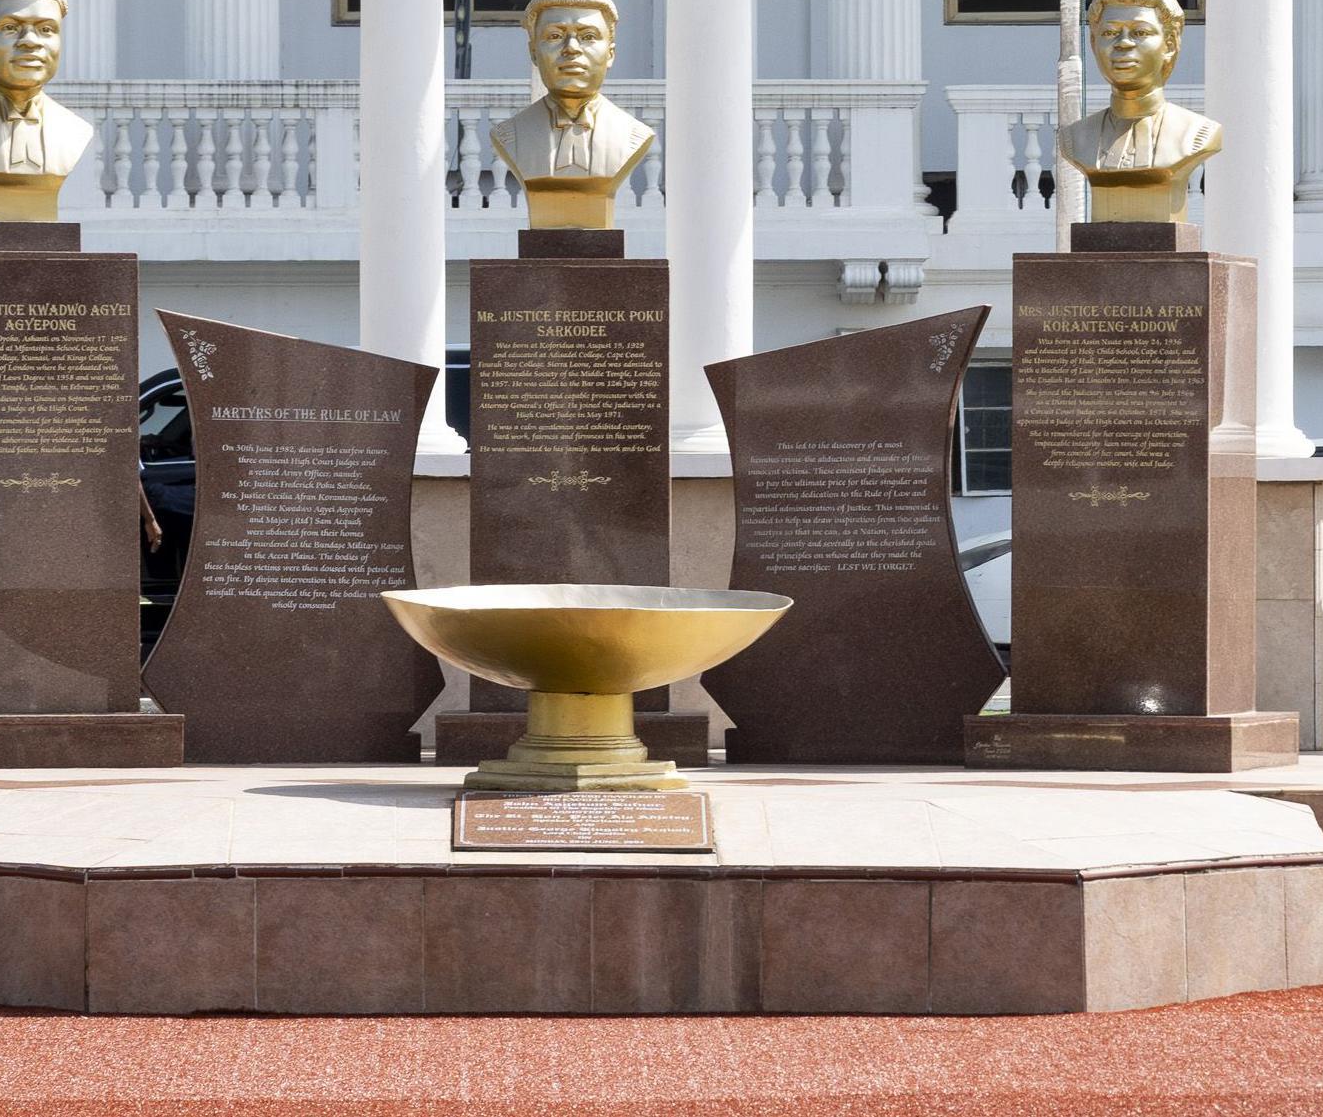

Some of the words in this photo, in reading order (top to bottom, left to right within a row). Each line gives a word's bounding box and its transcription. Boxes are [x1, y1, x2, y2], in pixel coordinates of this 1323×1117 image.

[28, 303, 87, 316] KWADWO
[90, 303, 131, 316] AGYEI
[1047, 305, 1100, 317] JUSTICE
[1103, 305, 1153, 317] CECILIA
[1156, 305, 1203, 317] AFRAN
[500, 310, 552, 322] JUSTICE
[554, 310, 626, 323] FREDERICK
[629, 310, 664, 322] POKU
[5, 318, 77, 331] AGYEPONG
[1043, 319, 1179, 332] KORANTENG-ADDOW
[537, 325, 607, 337] SARKODEE
[211, 406, 272, 419] MARTYRS
[274, 407, 290, 419] OF
[293, 408, 318, 420] THE
[320, 408, 351, 421] RULE
[354, 409, 370, 421] OF
[373, 408, 402, 422] LAW
[222, 444, 235, 452] On
[255, 445, 273, 455] June
[298, 446, 324, 456] during
[326, 446, 338, 454] the
[339, 446, 365, 456] curfew
[238, 456, 257, 464] three
[258, 456, 290, 464] eminent
[291, 457, 310, 467] High
[312, 457, 334, 465] Court
[335, 457, 360, 467] Judges
[362, 458, 376, 466] and
[238, 480, 251, 488] Mr.
[253, 480, 278, 490] Justice
[315, 481, 335, 489] Poku
[756, 479, 765, 487] to
[766, 481, 780, 489] pay
[781, 479, 793, 487] the
[794, 479, 826, 487] ultimate
[827, 478, 846, 488] price
[847, 478, 858, 488] for
[861, 478, 878, 486] their
[880, 477, 911, 487] singular
[913, 477, 927, 485] and
[221, 491, 238, 499] Mrs.
[239, 491, 265, 501] Justice
[267, 492, 293, 500] Cecilia
[294, 492, 316, 502] Afran
[237, 503, 250, 511] Mr.
[251, 503, 277, 513] Justice
[278, 504, 312, 512] Kwadwo
[314, 504, 335, 514] Agyei
[249, 516, 264, 524] and
[265, 516, 288, 526] Major
[315, 517, 332, 525] Sam
[266, 528, 299, 536] abducted
[300, 529, 319, 539] from
[320, 529, 338, 537] their
[340, 529, 364, 537] homes
[205, 538, 220, 546] and
[221, 539, 252, 549] brutally
[253, 539, 288, 547] murdered
[289, 540, 298, 548] at
[300, 540, 312, 548] the
[347, 541, 378, 551] Military
[244, 551, 252, 559] in
[254, 551, 265, 559] the
[267, 551, 289, 560] Accra
[318, 552, 333, 560] The
[335, 553, 359, 561] bodies
[360, 553, 369, 563] of
[204, 562, 223, 570] these
[224, 563, 252, 573] hapless
[253, 563, 281, 571] victims
[301, 564, 318, 572] then
[319, 564, 346, 572] doused
[347, 565, 365, 573] with
[367, 565, 389, 575] petrol
[390, 565, 405, 573] and
[202, 574, 213, 582] set
[243, 575, 254, 585] By
[255, 575, 279, 583] divine
[280, 576, 327, 584] intervention
[328, 576, 336, 584] in
[338, 576, 350, 584] the
[351, 577, 370, 587] form
[371, 577, 380, 587] of
[388, 577, 405, 587] light
[238, 588, 261, 596] which
[263, 589, 297, 599] quenched
[299, 589, 311, 597] the
[330, 590, 342, 598] the
[343, 590, 367, 598] bodies
[271, 600, 297, 610] wholly
